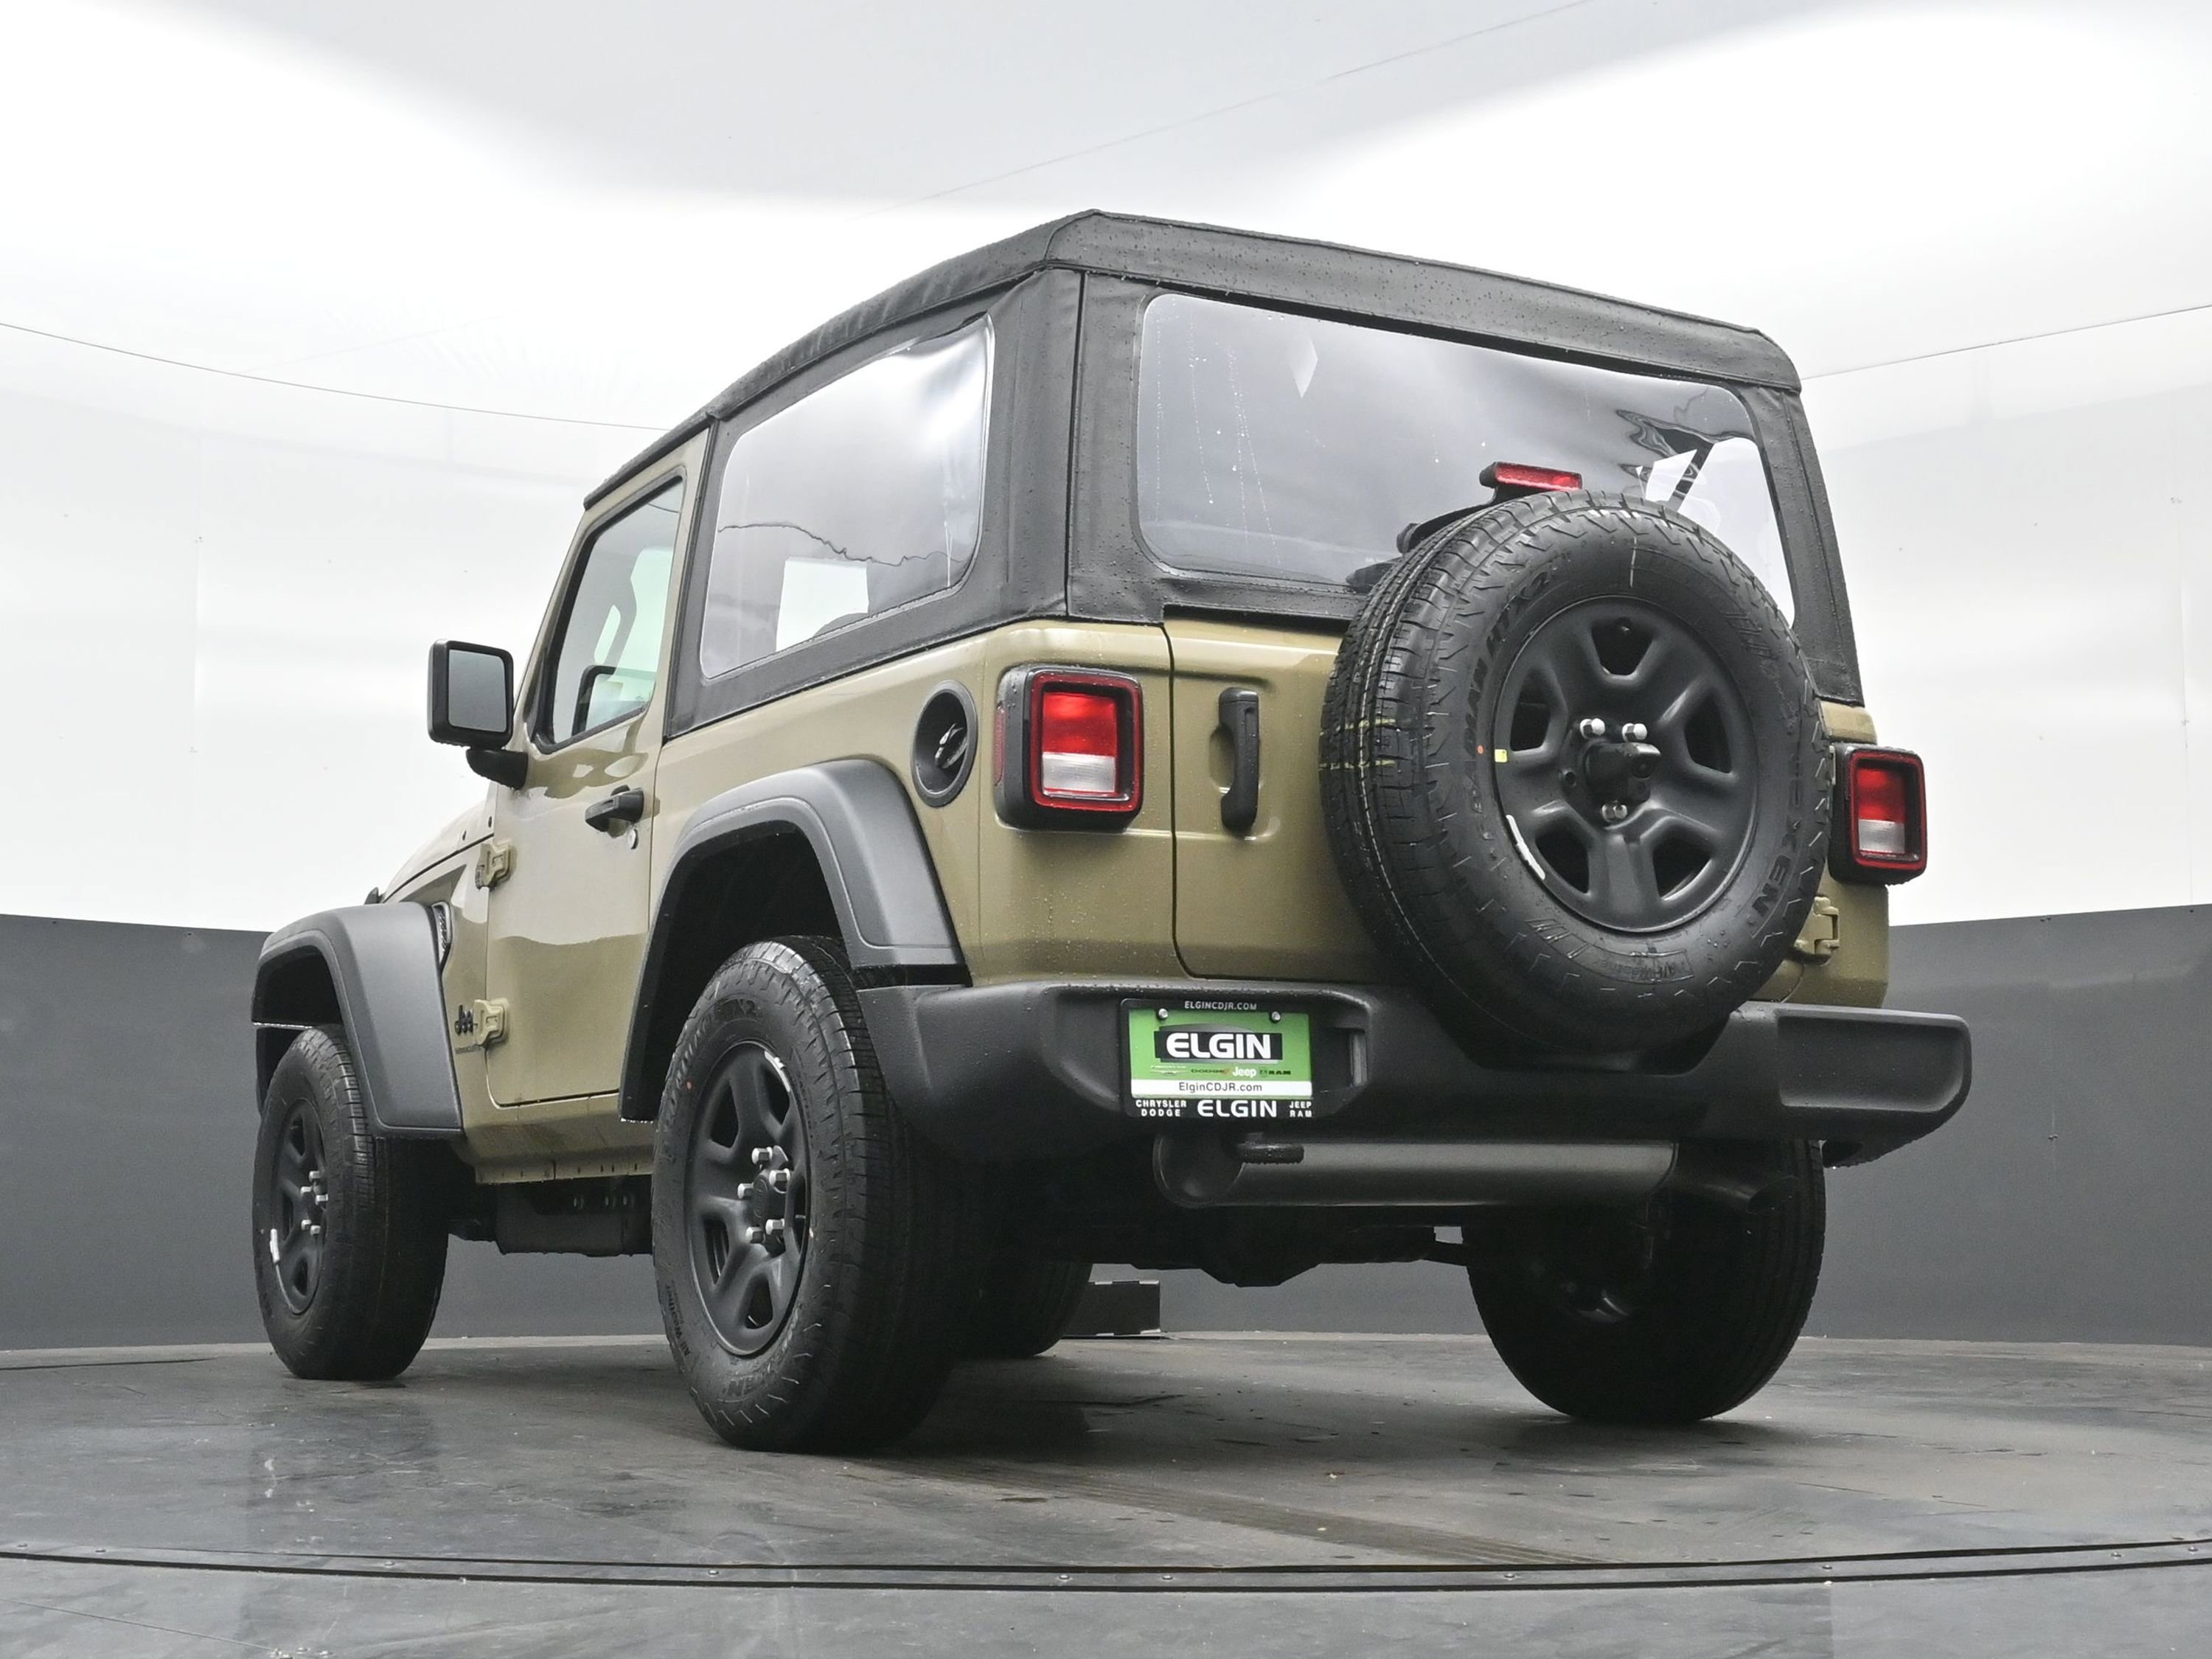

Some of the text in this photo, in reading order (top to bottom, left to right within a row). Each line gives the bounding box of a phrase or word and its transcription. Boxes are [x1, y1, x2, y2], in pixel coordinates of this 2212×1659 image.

[1184, 1001, 1257, 1010] ELGINCDJR.COM
[1166, 1032, 1271, 1059] ELGIN
[1232, 1066, 1256, 1078] Jeep
[1179, 1082, 1262, 1093] ElginCDJR.com
[1135, 1099, 1187, 1108] CHRYSLER
[1289, 1101, 1312, 1109] JEEP
[1141, 1108, 1180, 1117] DODGE
[1197, 1099, 1277, 1118] ELGIN
[1290, 1110, 1312, 1118] RAM
